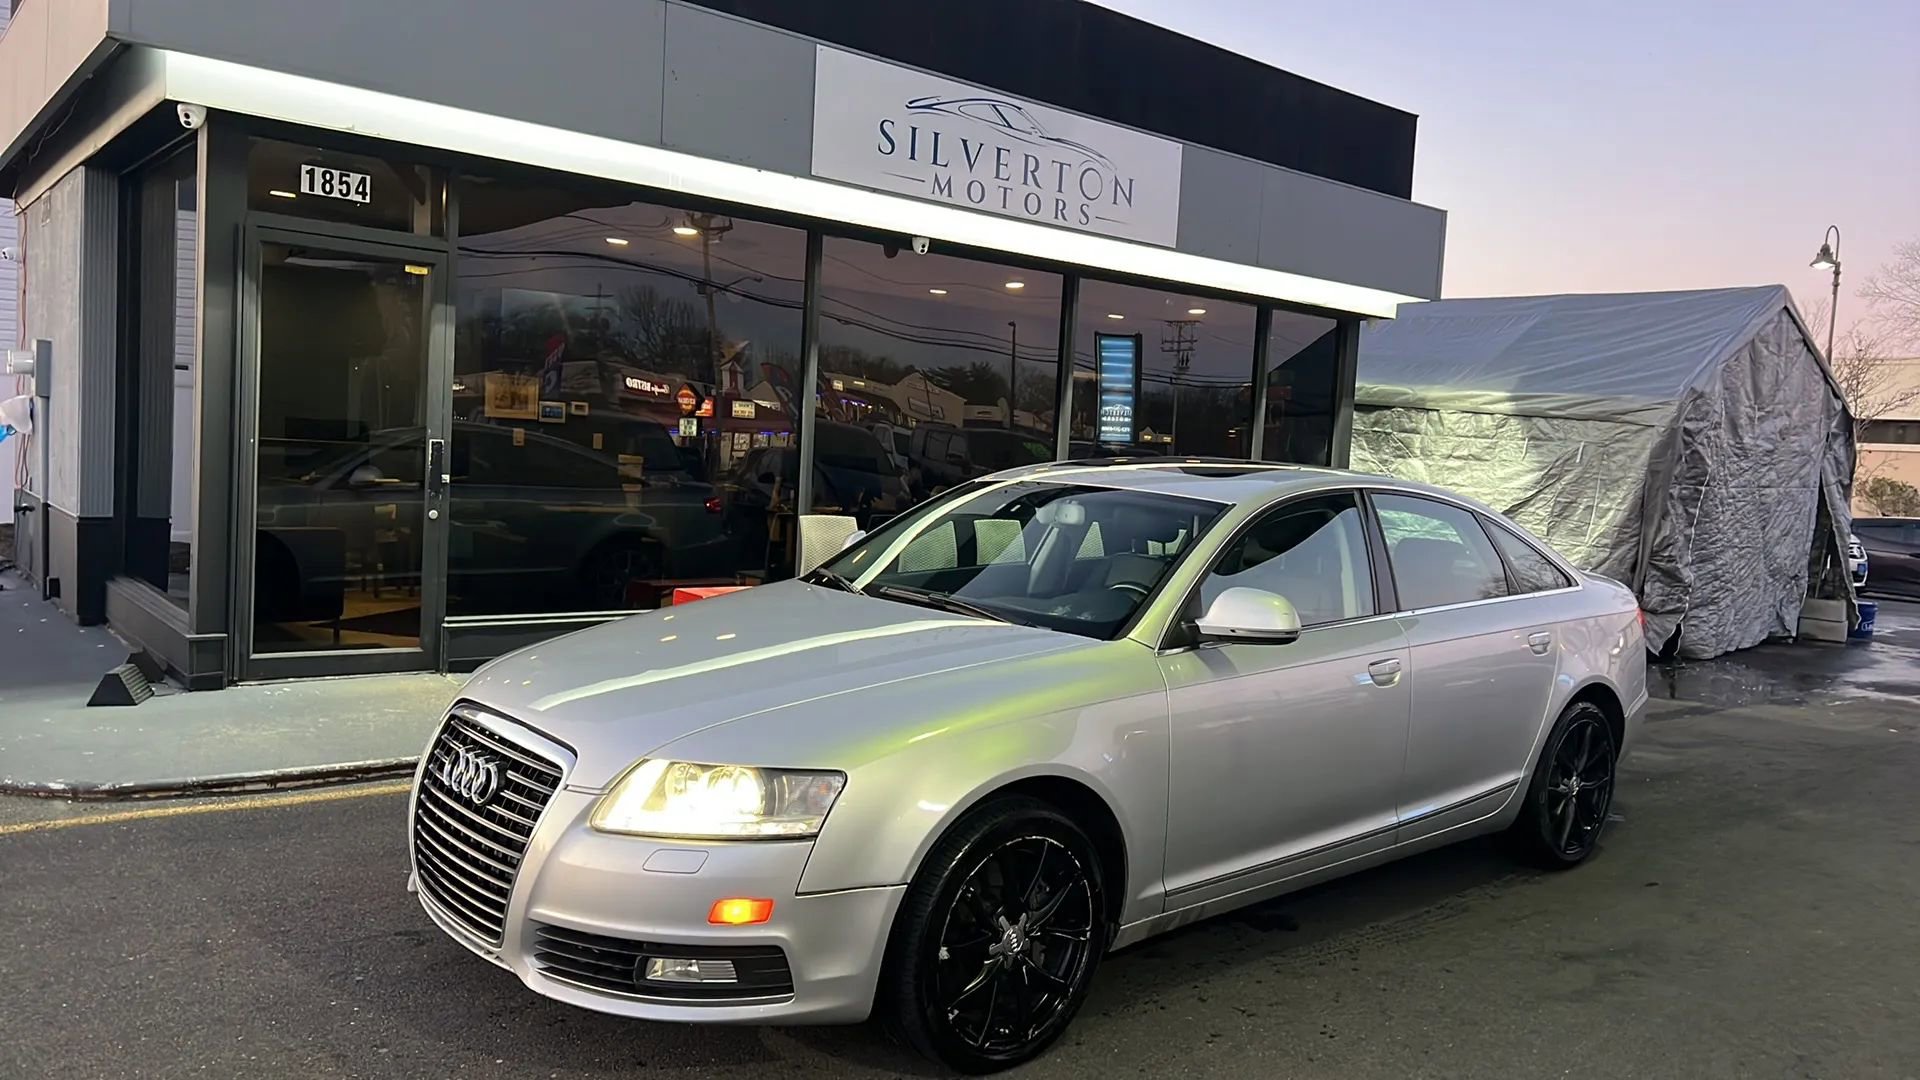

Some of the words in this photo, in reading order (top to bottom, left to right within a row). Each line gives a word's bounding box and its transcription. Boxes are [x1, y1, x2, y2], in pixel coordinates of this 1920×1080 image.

[305, 167, 369, 201] 1854
[877, 118, 1135, 208] SILVERTON
[931, 172, 1091, 226] MOTORS
